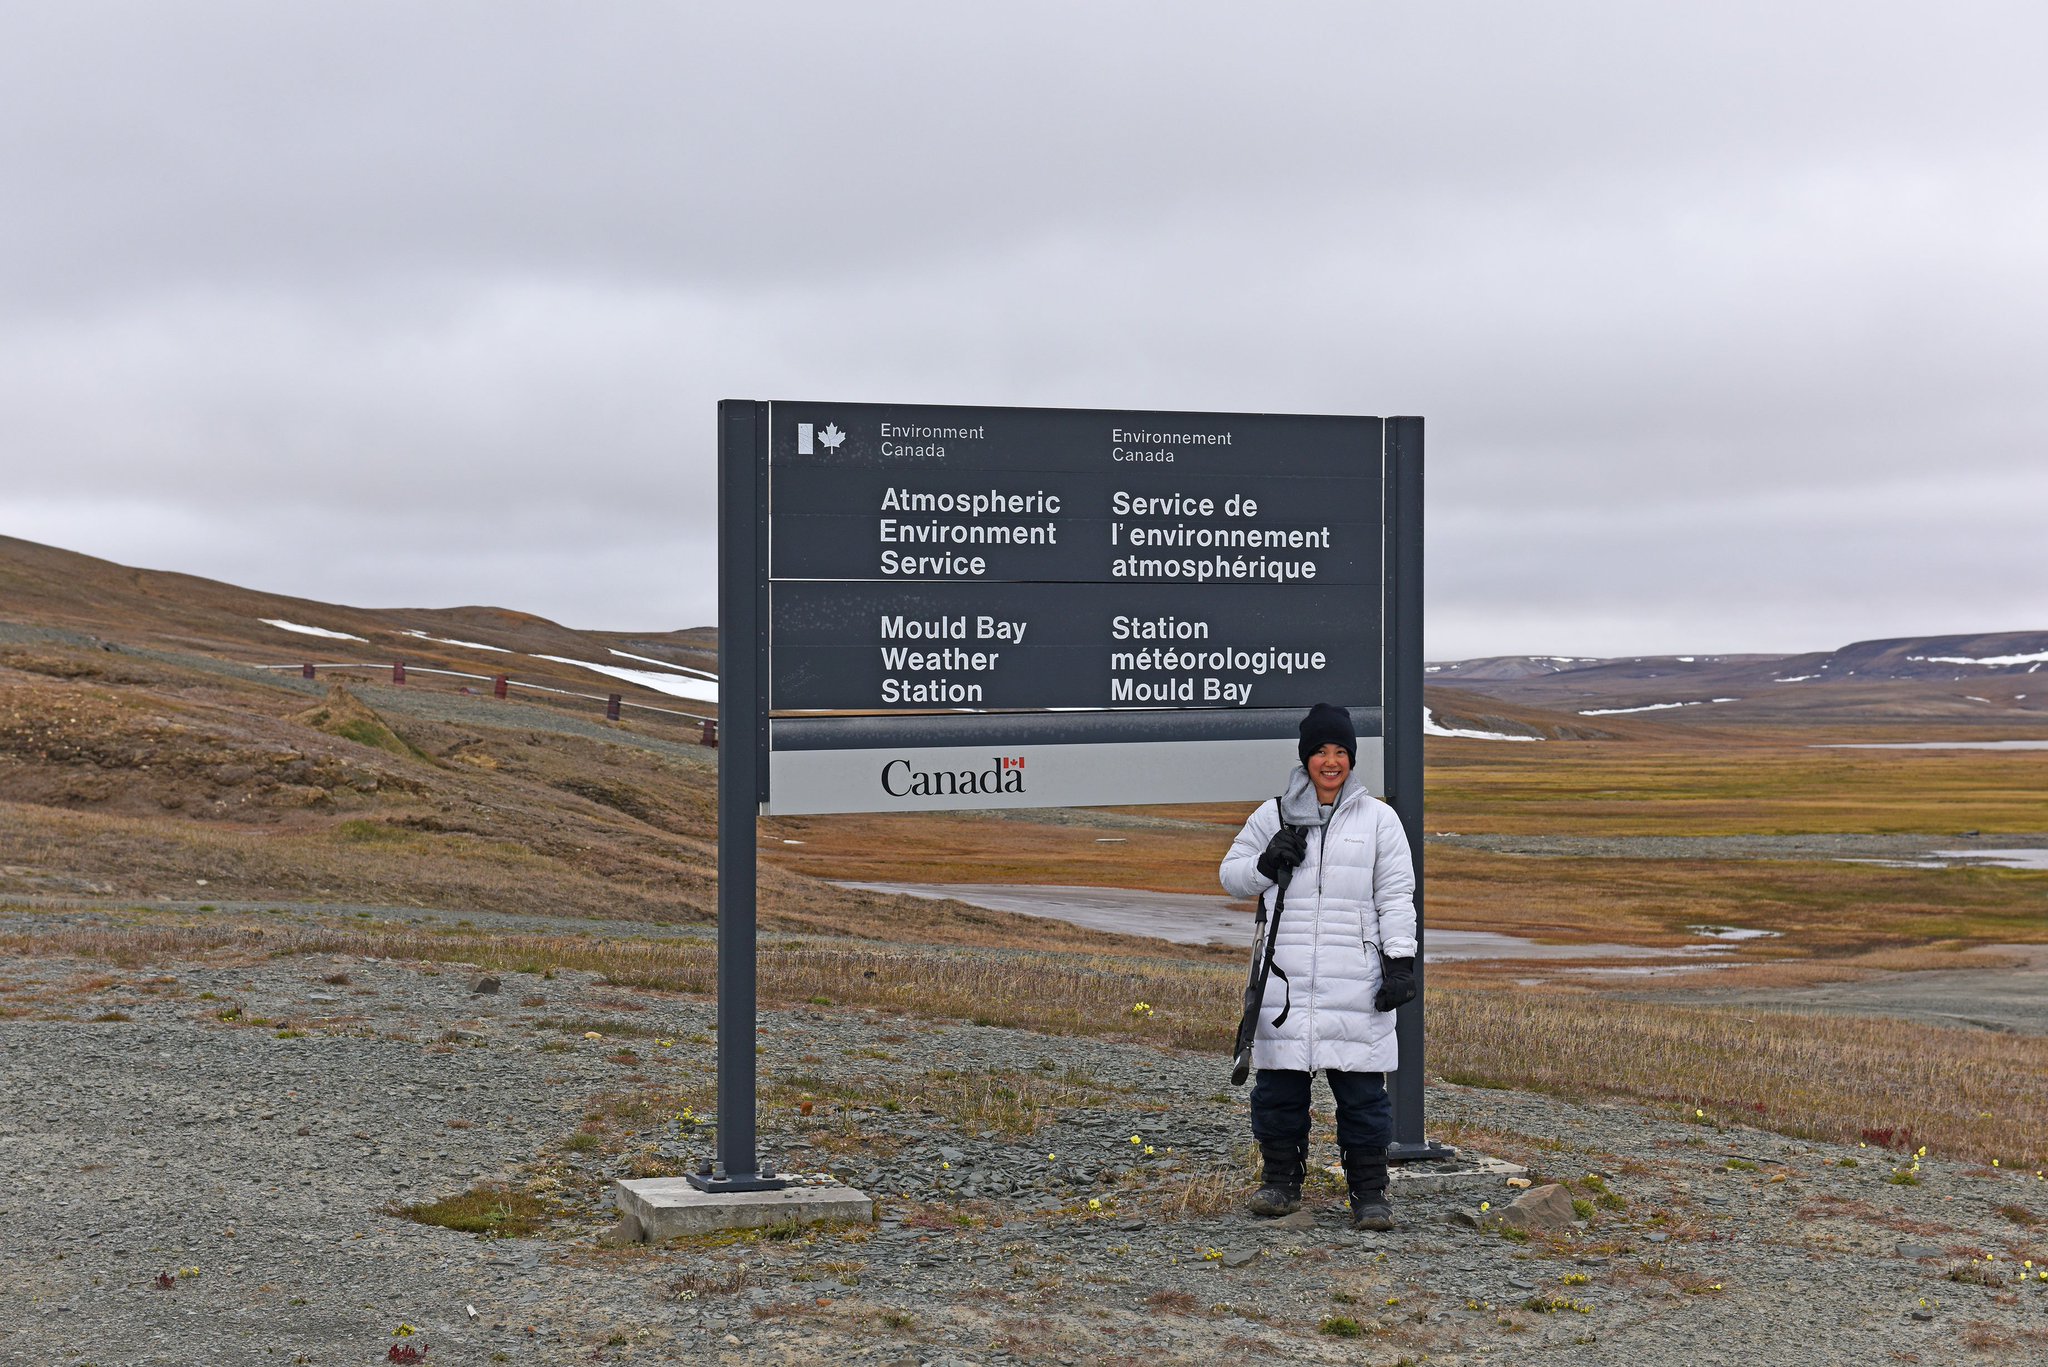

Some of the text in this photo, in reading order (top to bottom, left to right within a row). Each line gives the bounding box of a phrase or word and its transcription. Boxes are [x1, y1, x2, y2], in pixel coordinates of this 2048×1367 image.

[881, 422, 985, 440] Environment
[1112, 428, 1232, 446] Environnement
[881, 441, 945, 458] Canada
[1112, 447, 1175, 463] Canada
[880, 487, 1061, 518] Atmospheric
[1112, 491, 1258, 518] Service de
[880, 518, 1057, 545] Environment
[880, 549, 986, 576] Service
[1111, 554, 1317, 583] atmosphérique
[881, 615, 1028, 645] Mould Bay
[1111, 615, 1209, 640] Station
[880, 647, 1000, 671] Weather
[1111, 646, 1326, 675] météorologique
[881, 678, 983, 703] Station
[1111, 677, 1253, 706] Mould Bay
[881, 757, 1027, 797] Canada
